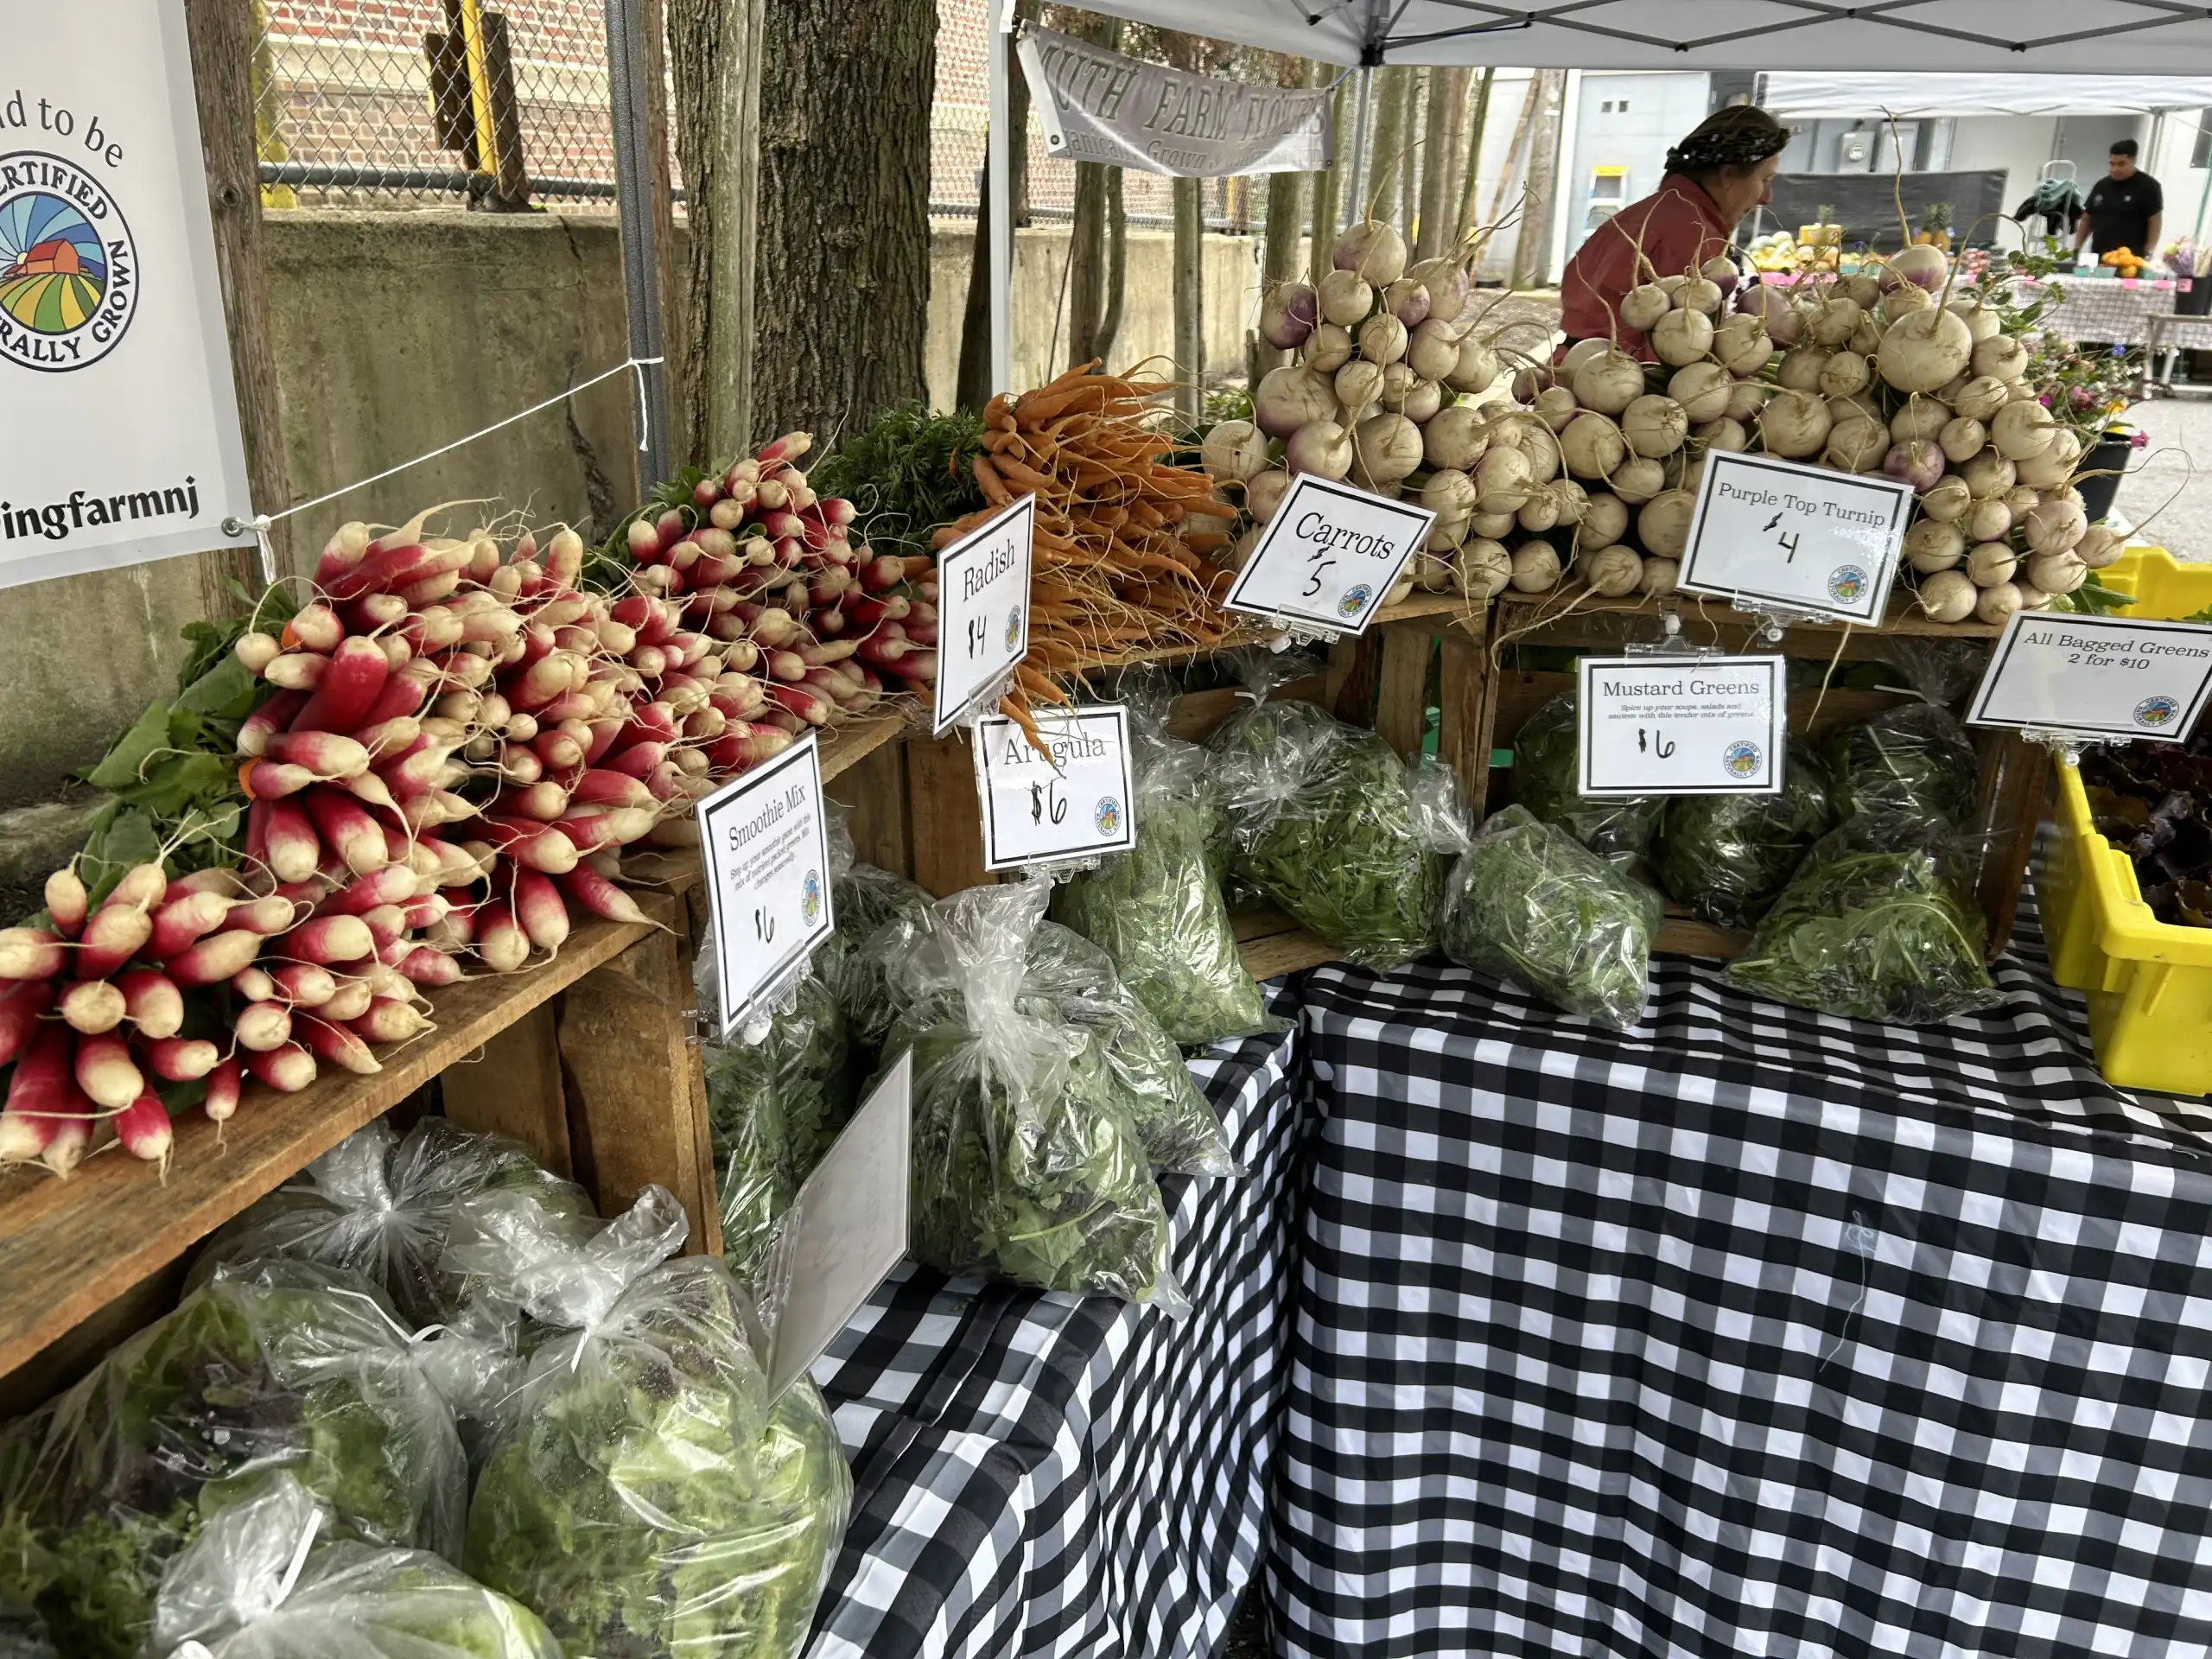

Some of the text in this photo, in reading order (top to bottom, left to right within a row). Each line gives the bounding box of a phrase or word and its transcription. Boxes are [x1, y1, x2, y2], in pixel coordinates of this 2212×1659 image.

[38, 98, 74, 137] to
[85, 115, 123, 168] be
[1144, 79, 1236, 141] FARM
[1147, 140, 1208, 169] Grown
[91, 239, 130, 343] GROWN
[1718, 482, 1885, 529] Purple Top Turnip
[1295, 512, 1396, 560] Carrots
[963, 537, 1015, 602] Radish
[968, 614, 987, 659] $4
[2023, 632, 2210, 658] All Bagged Greens
[2068, 652, 2151, 670] 2 for $10
[1603, 679, 1760, 696] Mustard Greens
[1638, 728, 1675, 760] $6
[728, 784, 806, 852] Smoothie Mix
[1031, 779, 1068, 827] $6
[754, 905, 775, 944] $6
